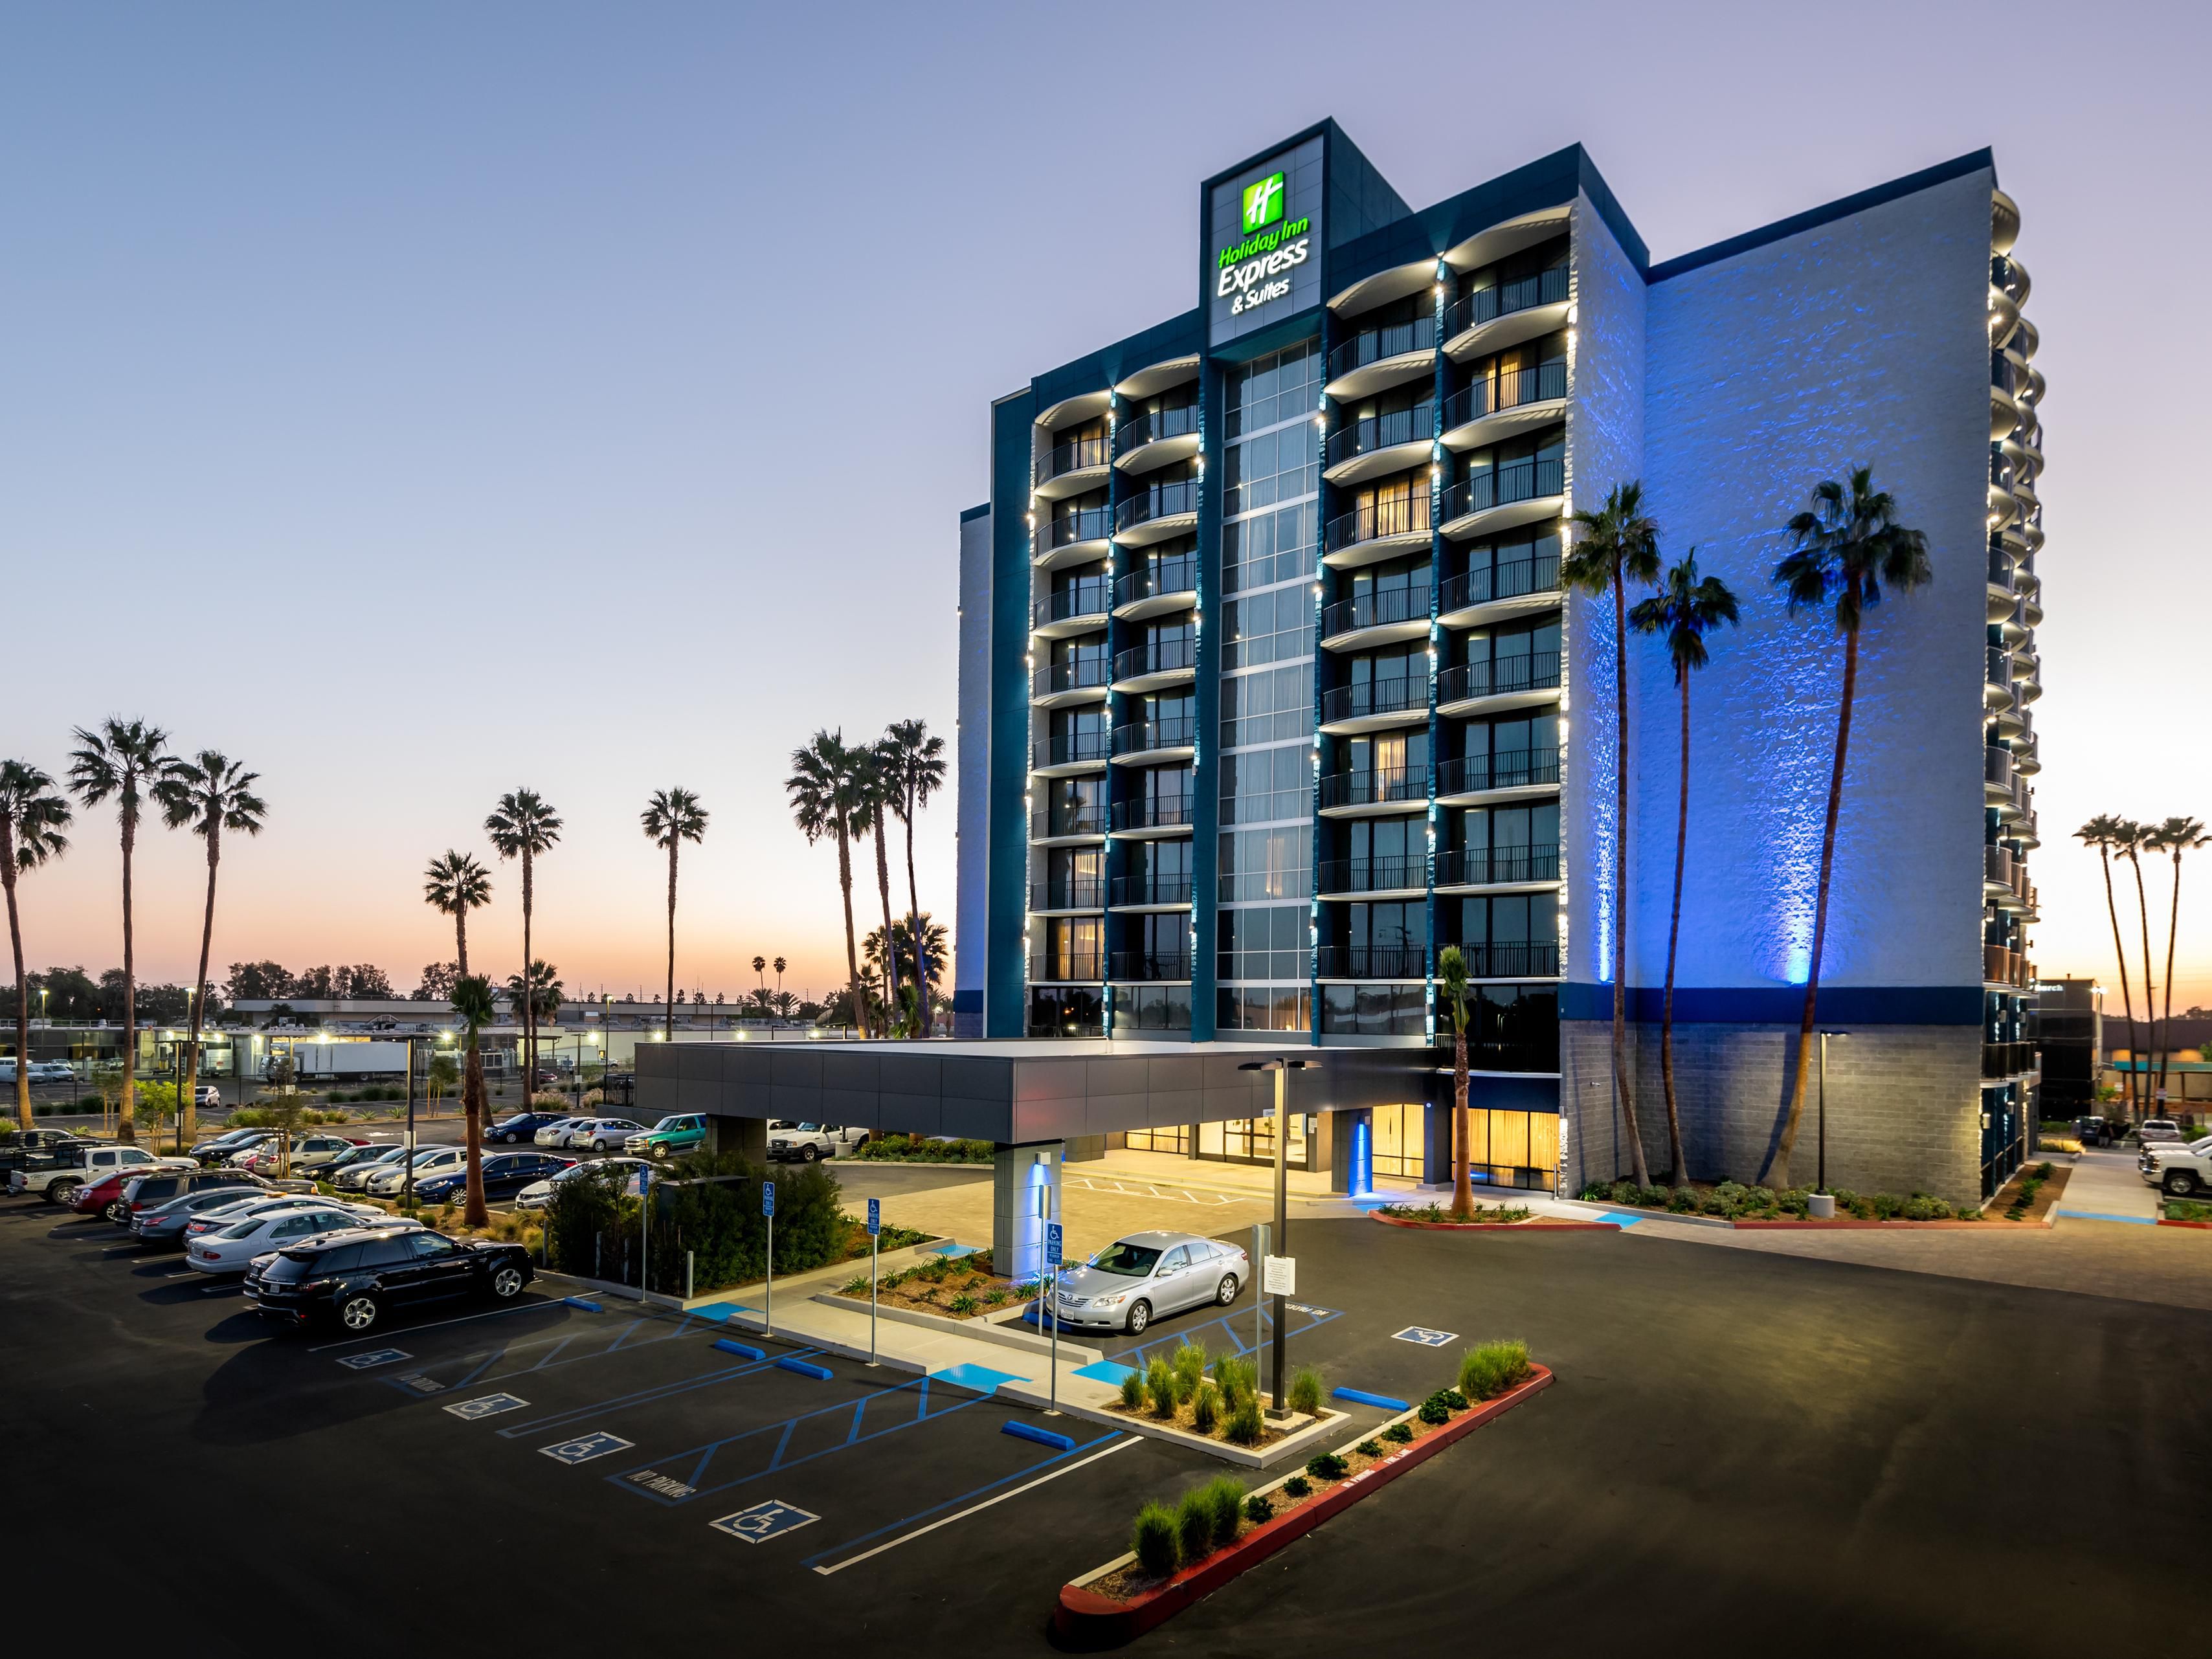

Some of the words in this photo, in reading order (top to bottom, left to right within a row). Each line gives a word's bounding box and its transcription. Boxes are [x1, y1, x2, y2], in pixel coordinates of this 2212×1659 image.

[1218, 230, 1280, 269] Holiday
[1281, 217, 1308, 241] Inn
[1218, 239, 1308, 296] Express
[1231, 295, 1243, 314] &
[1244, 278, 1290, 309] Suites
[1048, 1239, 1061, 1247] PARKING
[627, 1469, 658, 1481] NO
[642, 1476, 697, 1498] PARKING
